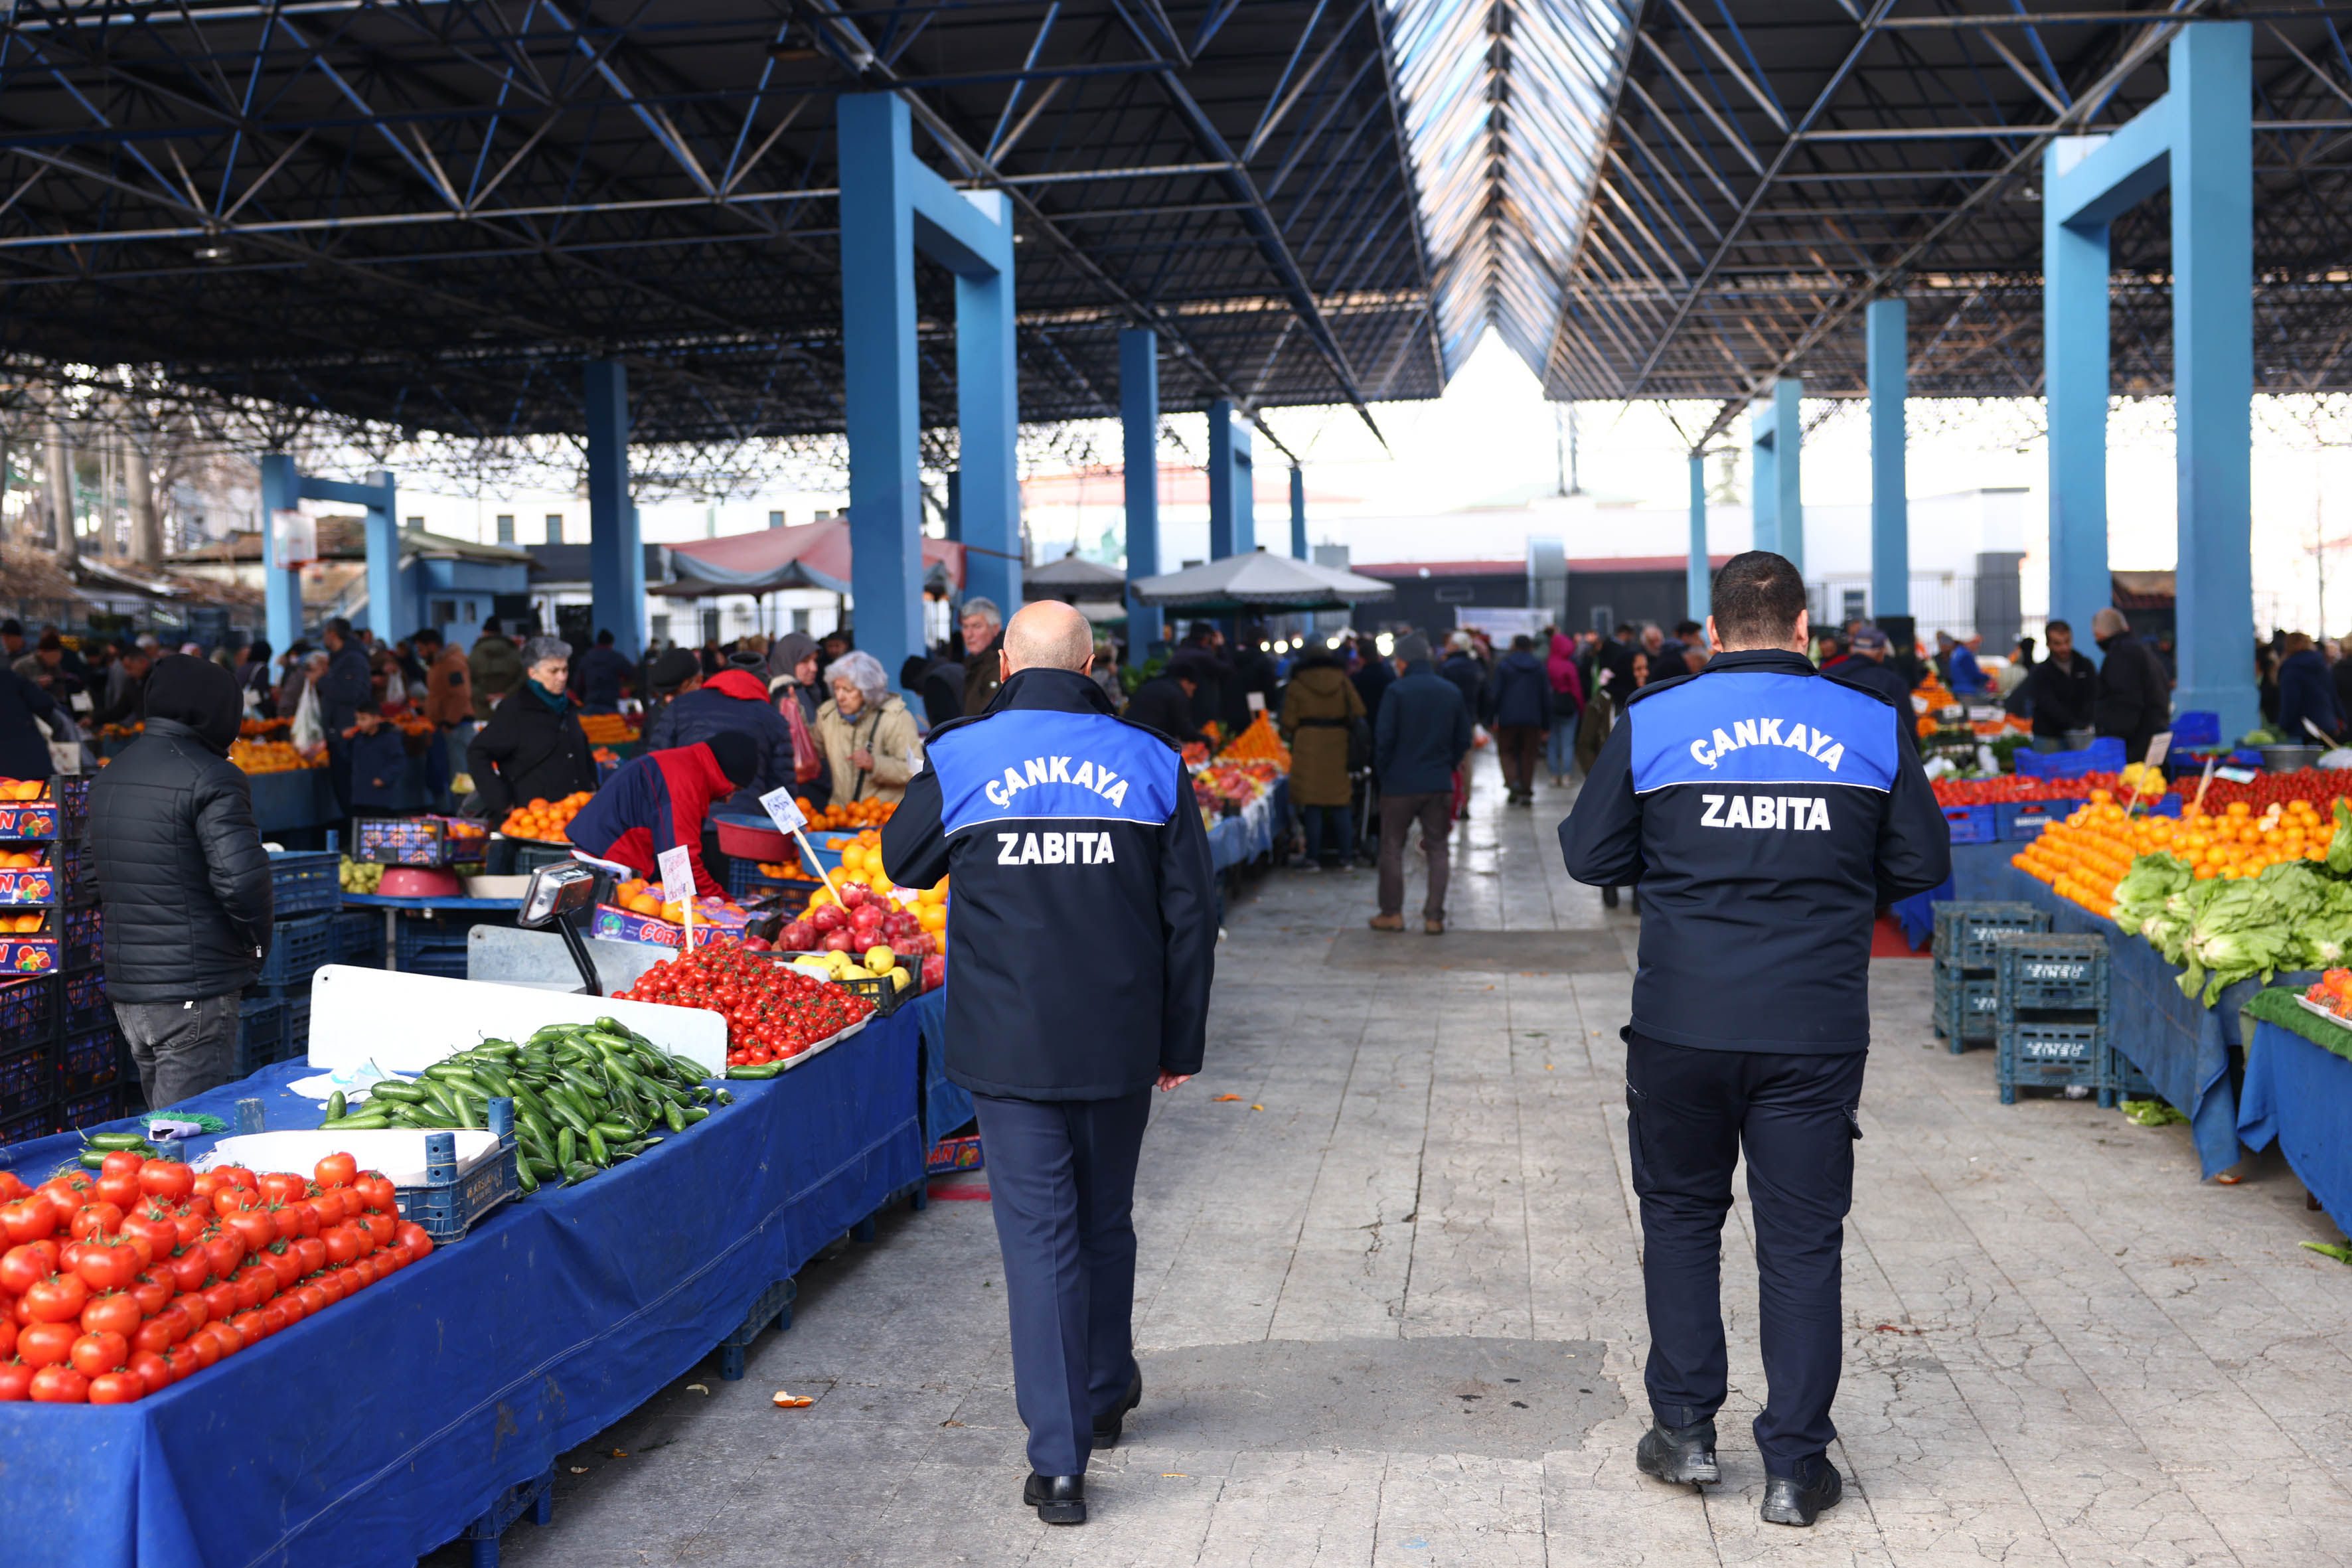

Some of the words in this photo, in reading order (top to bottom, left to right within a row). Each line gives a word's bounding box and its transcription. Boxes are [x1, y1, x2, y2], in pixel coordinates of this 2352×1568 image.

[1690, 718, 1845, 772] ÇANKAYA
[985, 755, 1129, 809] ÇANKAYA
[1700, 794, 1832, 831] ZABITA
[997, 832, 1116, 865] ZABITA
